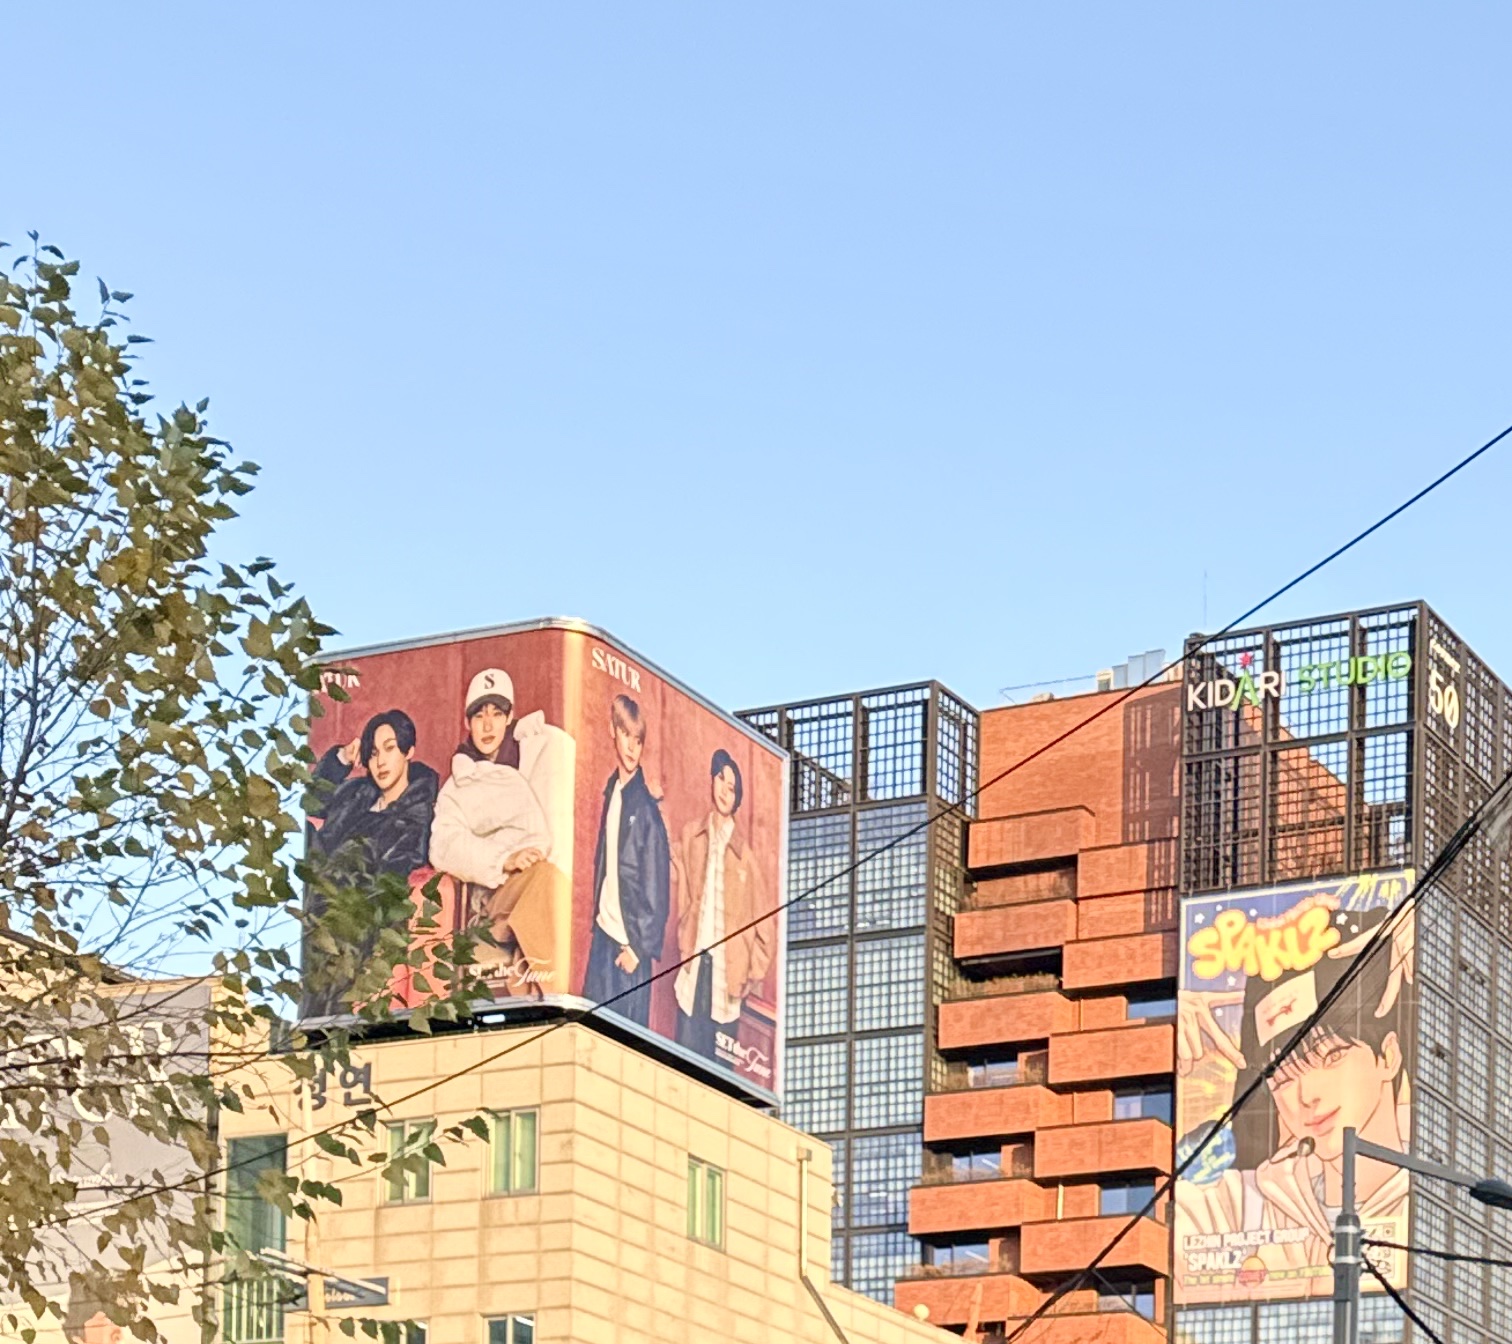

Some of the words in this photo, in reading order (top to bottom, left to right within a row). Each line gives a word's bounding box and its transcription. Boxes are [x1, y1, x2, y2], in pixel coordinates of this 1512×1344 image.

[484, 673, 495, 690] S
[591, 647, 642, 694] SATUR
[1187, 667, 1286, 712] KIDARI
[1300, 651, 1412, 693] STUDIO
[1222, 1230, 1271, 1247] PROJECT
